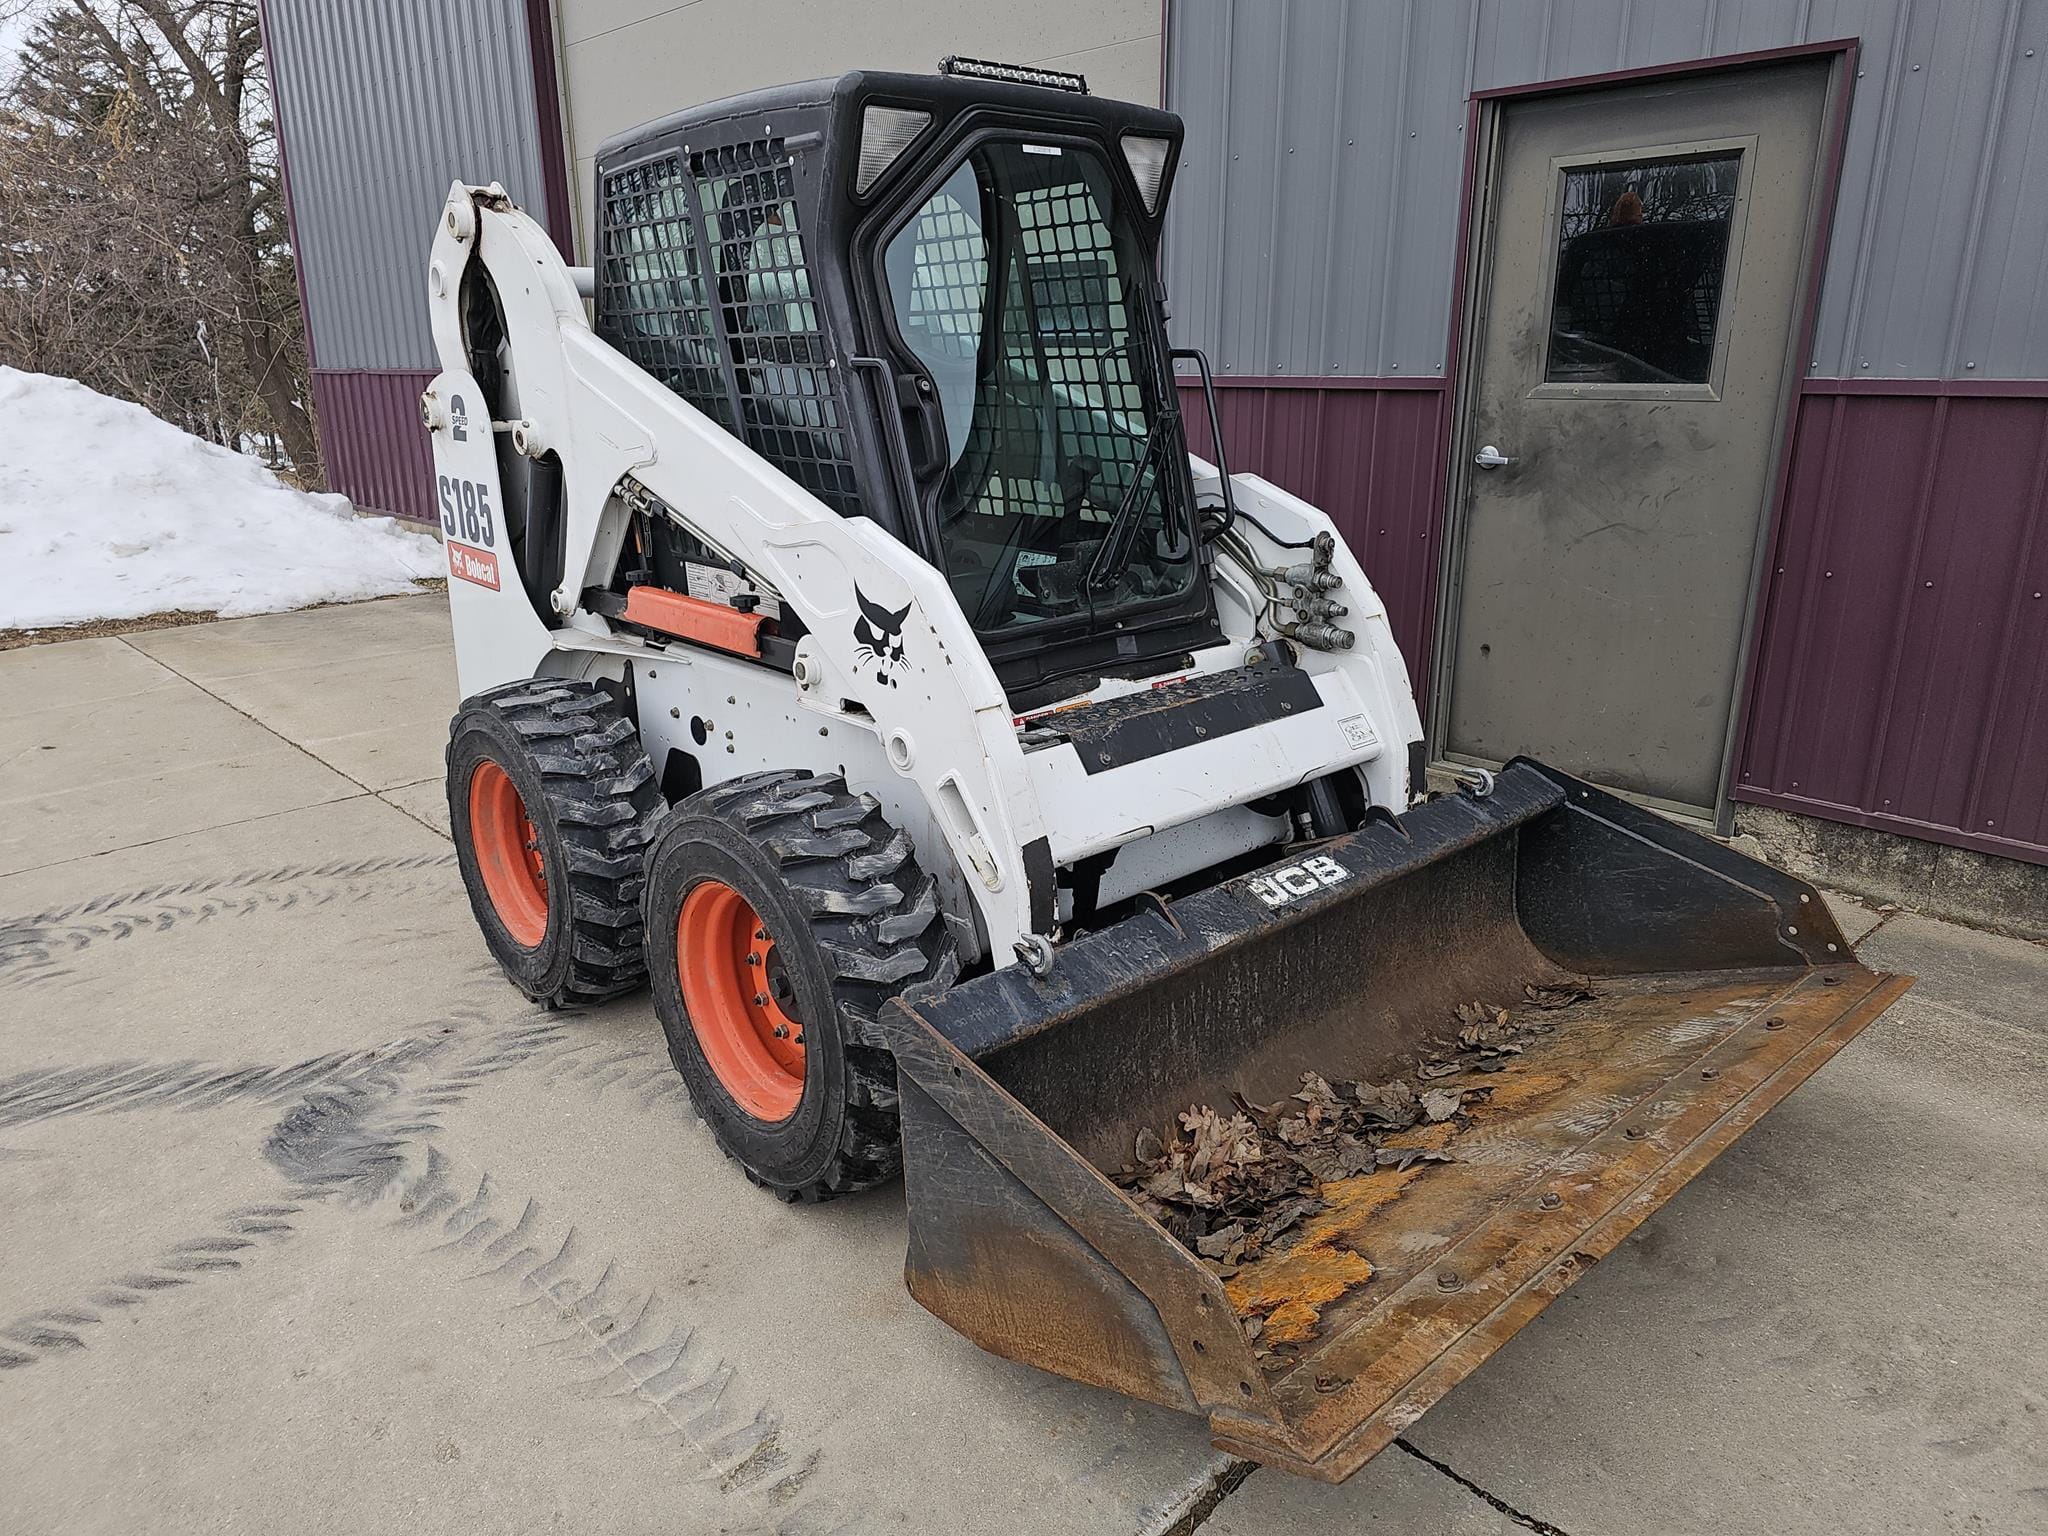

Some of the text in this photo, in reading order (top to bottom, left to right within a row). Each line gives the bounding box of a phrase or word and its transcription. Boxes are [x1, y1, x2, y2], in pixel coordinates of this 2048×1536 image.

[451, 394, 467, 442] 2
[452, 415, 468, 426] SPEED
[439, 475, 495, 548] S185
[465, 554, 497, 584] Bobcat
[1246, 856, 1348, 906] JCB
